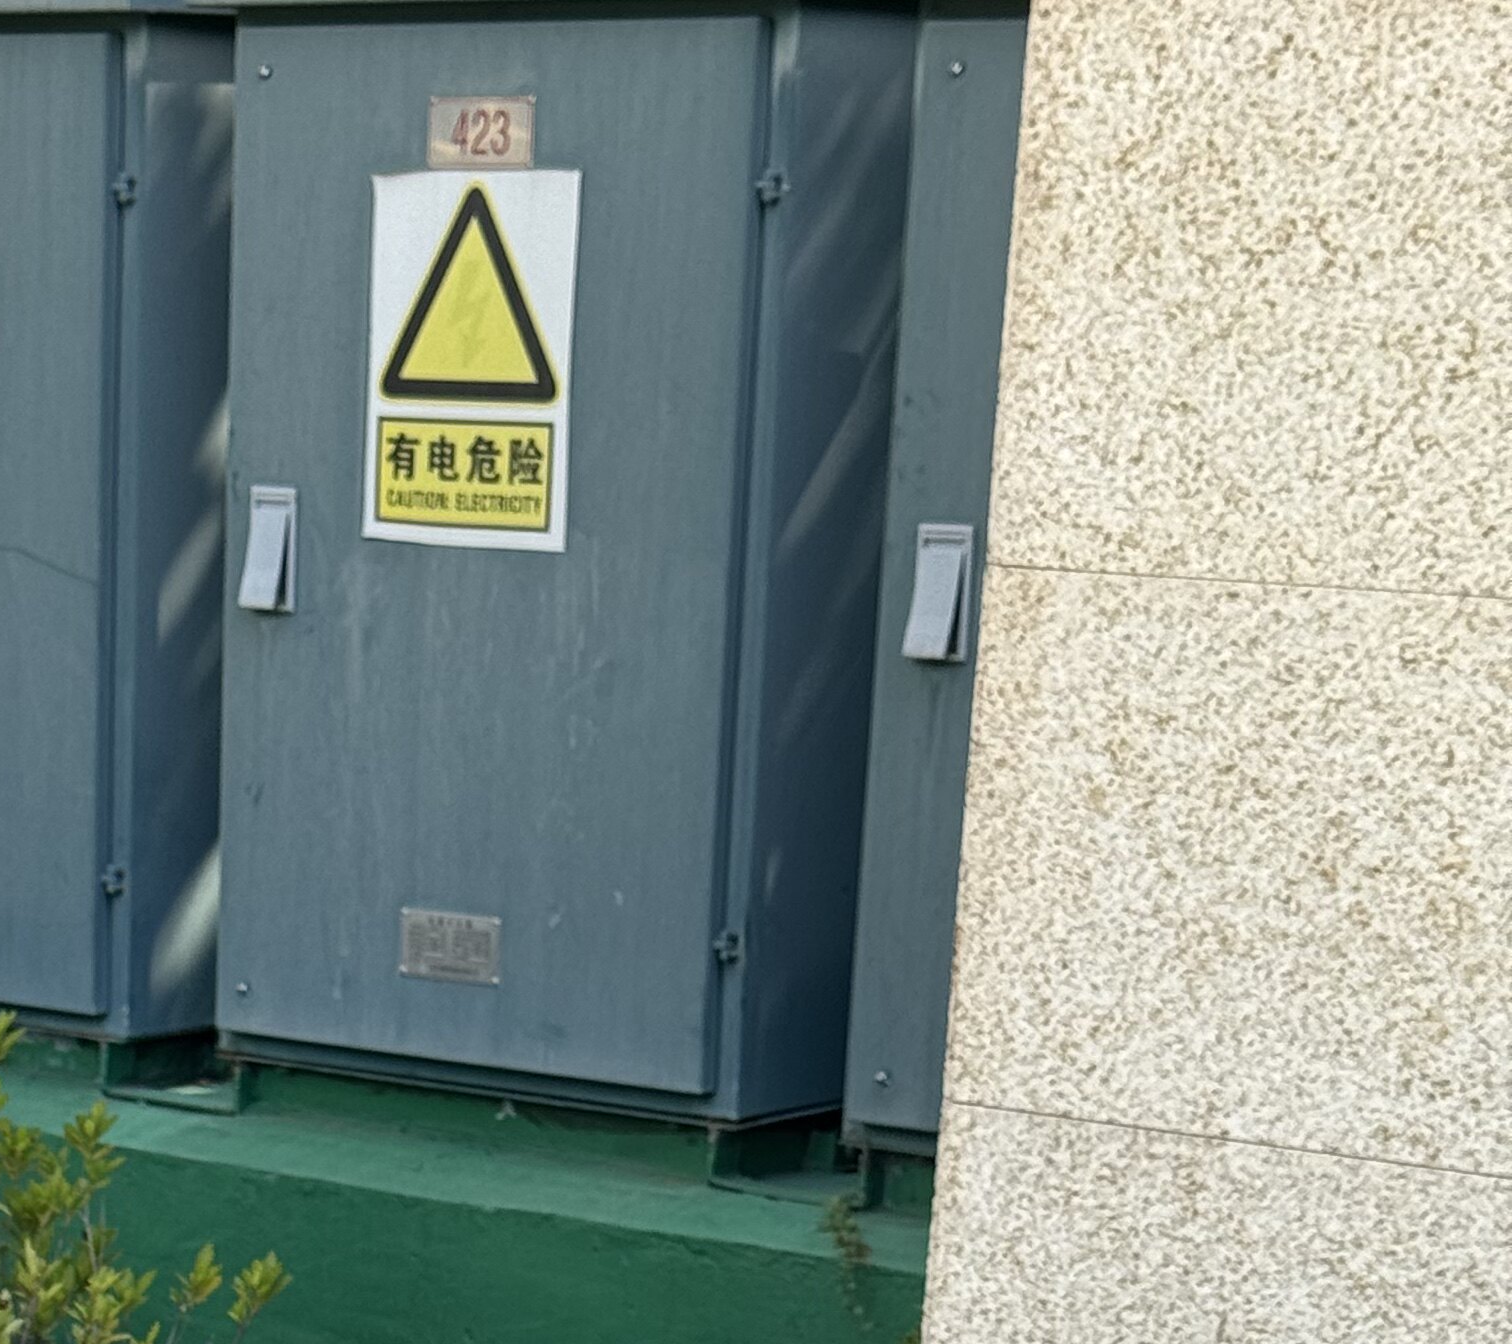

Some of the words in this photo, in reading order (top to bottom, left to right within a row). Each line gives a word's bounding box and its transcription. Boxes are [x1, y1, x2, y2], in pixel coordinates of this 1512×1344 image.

[451, 108, 512, 157] 423
[385, 432, 544, 485] 有电危险
